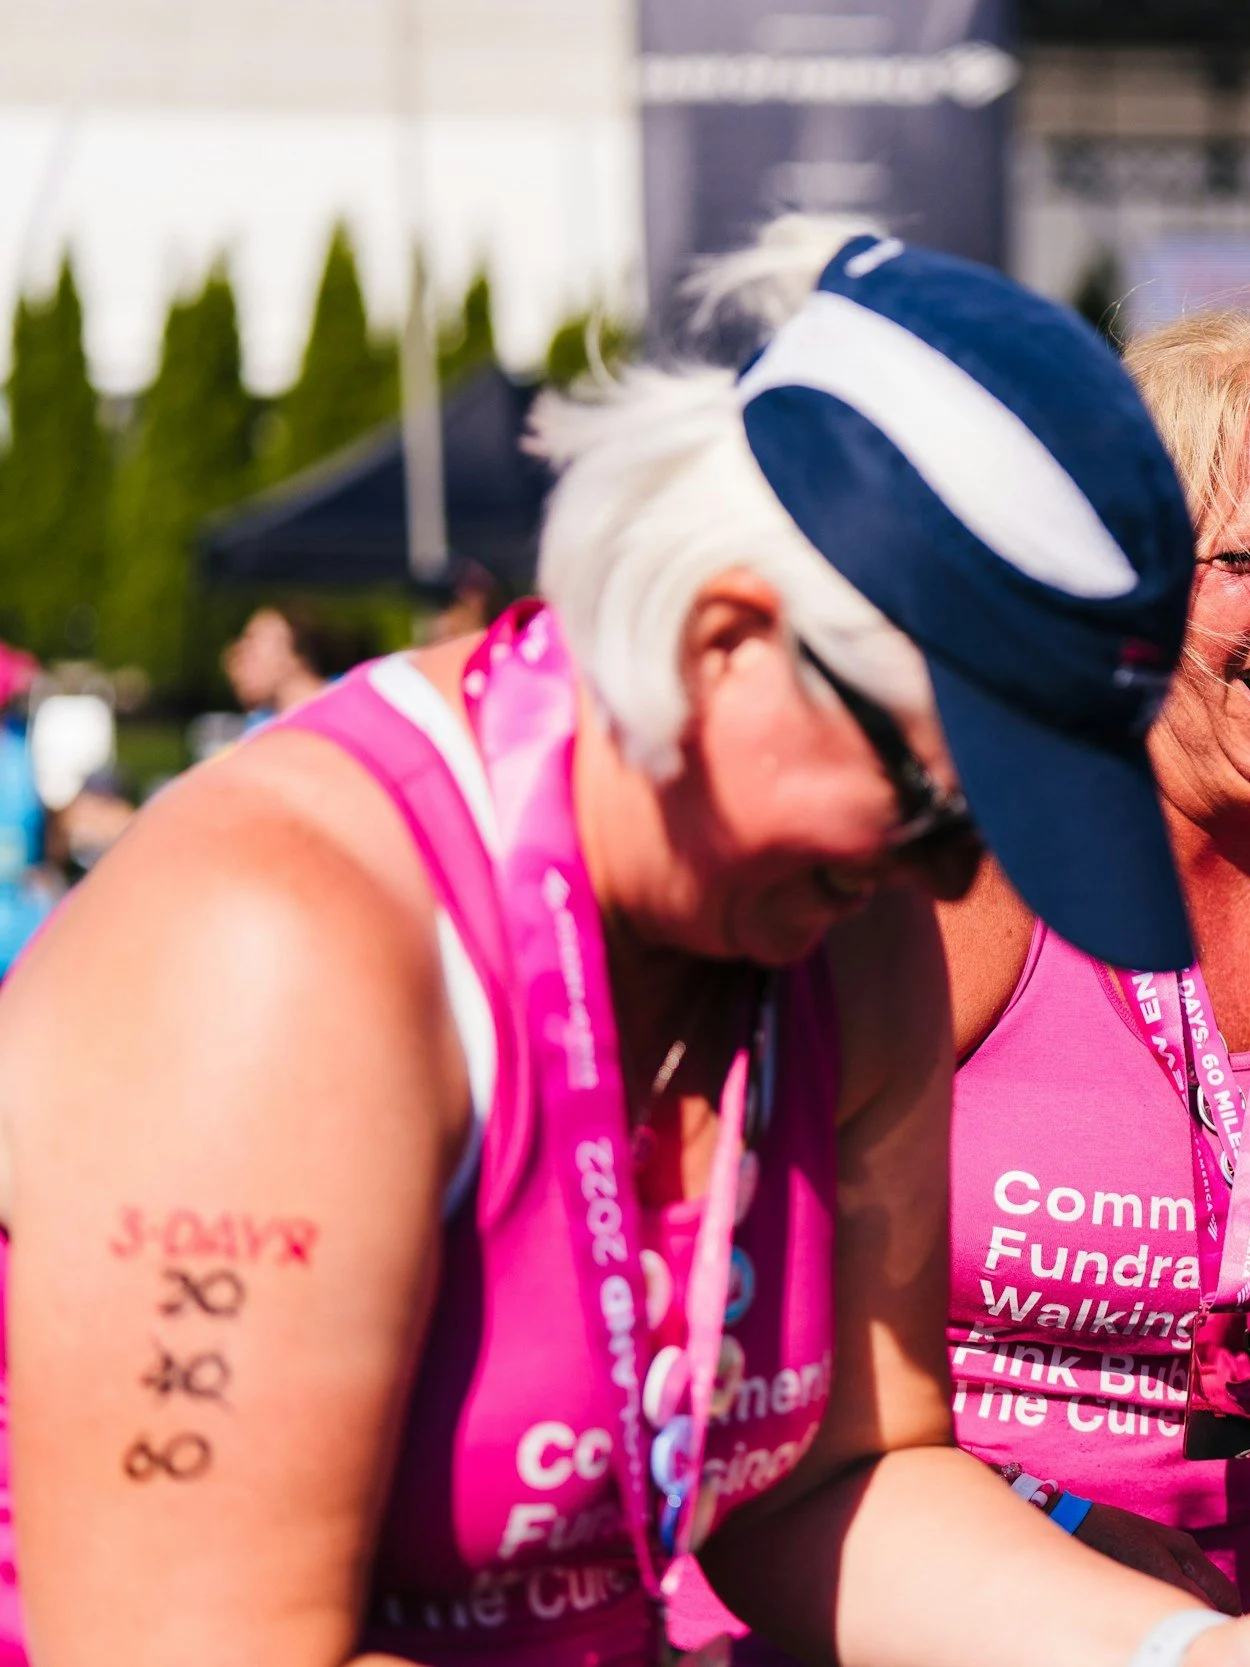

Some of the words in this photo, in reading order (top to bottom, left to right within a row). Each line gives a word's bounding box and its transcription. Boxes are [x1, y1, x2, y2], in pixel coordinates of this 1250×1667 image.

[1180, 978, 1209, 1049] DAYS.
[1202, 1054, 1225, 1087] 60
[120, 1430, 214, 1483] 60
